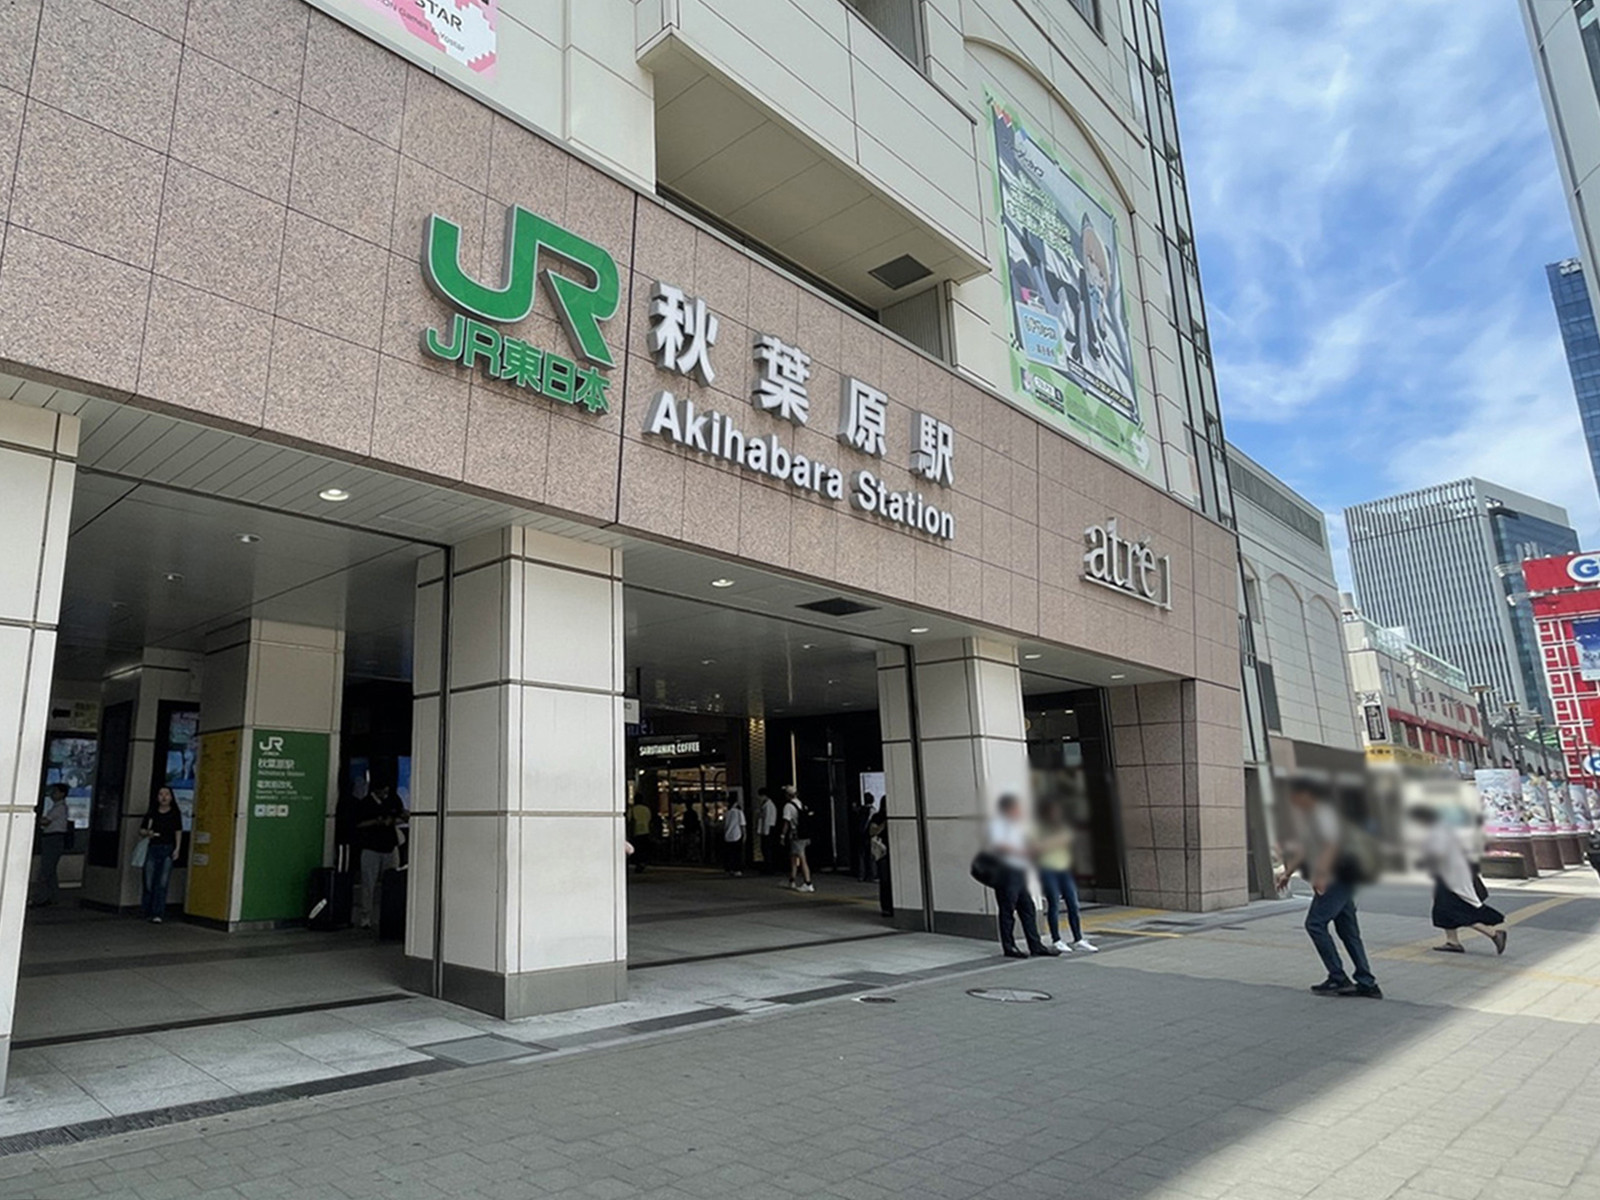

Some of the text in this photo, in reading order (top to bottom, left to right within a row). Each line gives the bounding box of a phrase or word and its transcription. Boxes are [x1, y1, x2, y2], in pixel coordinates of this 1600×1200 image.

[422, 203, 620, 368] JR
[425, 313, 611, 413] JR東日本
[650, 281, 954, 485] 秋葉原駅
[646, 391, 954, 540] Akihabara Station
[1573, 558, 1600, 578] G
[259, 736, 284, 751] JR
[676, 741, 700, 753] COFFEE
